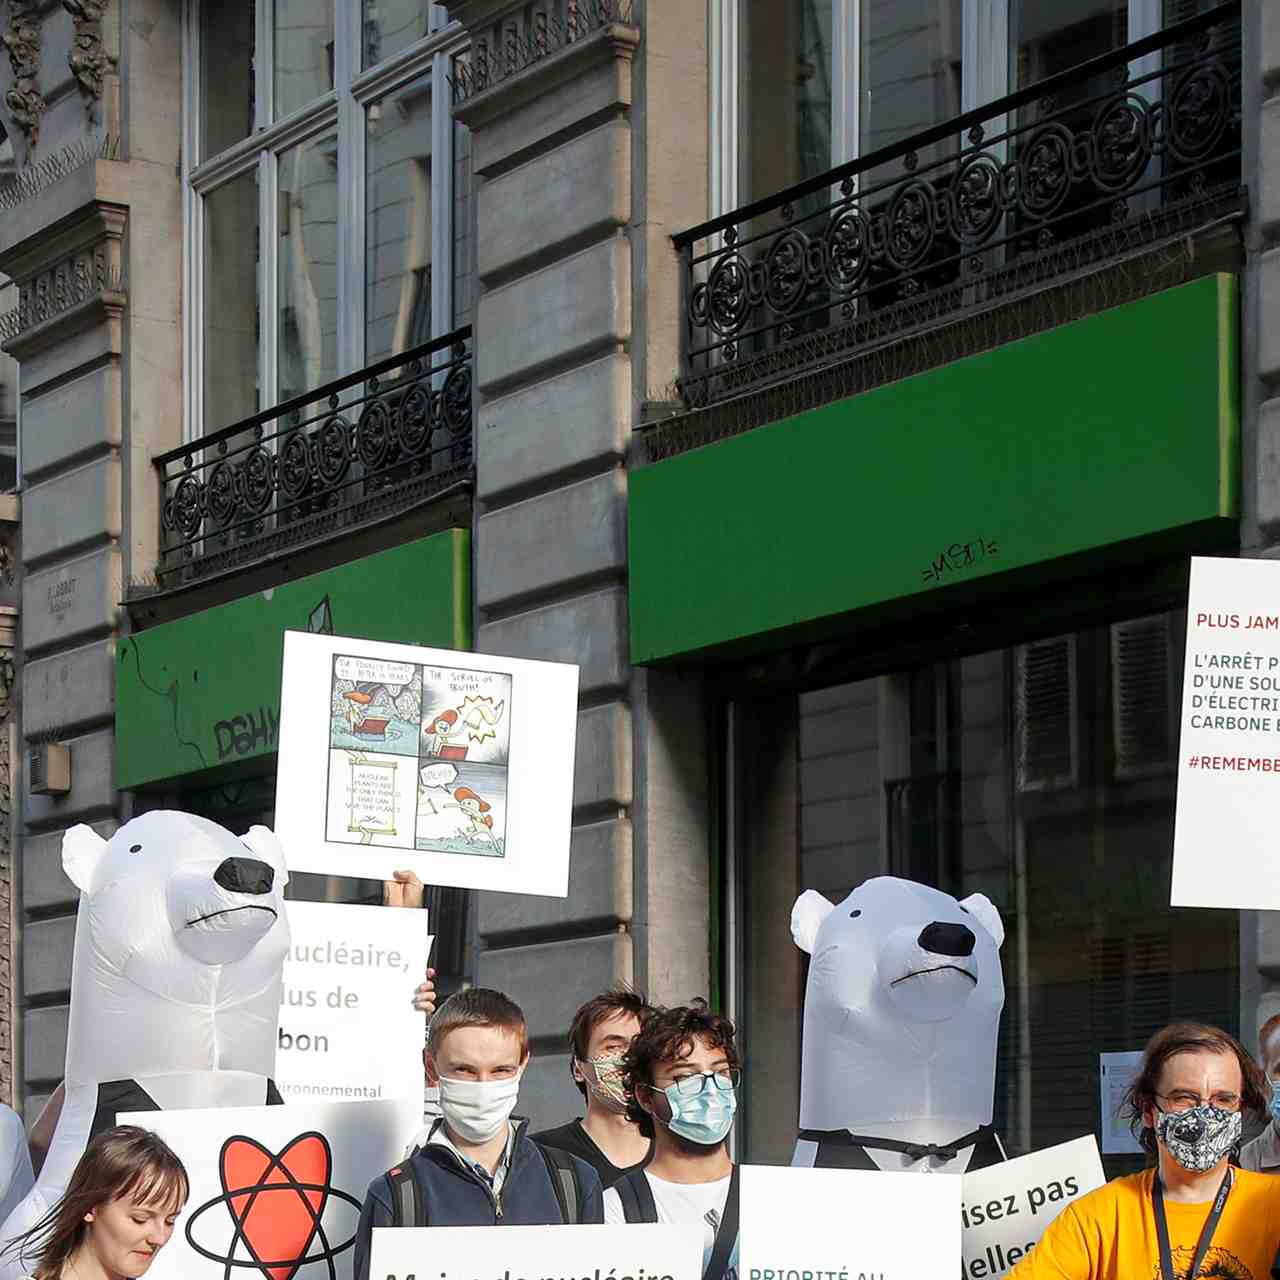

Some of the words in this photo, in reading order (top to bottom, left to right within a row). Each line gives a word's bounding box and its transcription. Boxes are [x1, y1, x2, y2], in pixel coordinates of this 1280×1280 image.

[1196, 613, 1240, 629] PLUS
[1194, 651, 1264, 670] L'ARRÊT
[1193, 675, 1244, 690] D'UNE
[1190, 715, 1271, 732] CARBONE
[326, 985, 359, 1009] de
[278, 1026, 329, 1053] bon
[1025, 1173, 1080, 1213] pas
